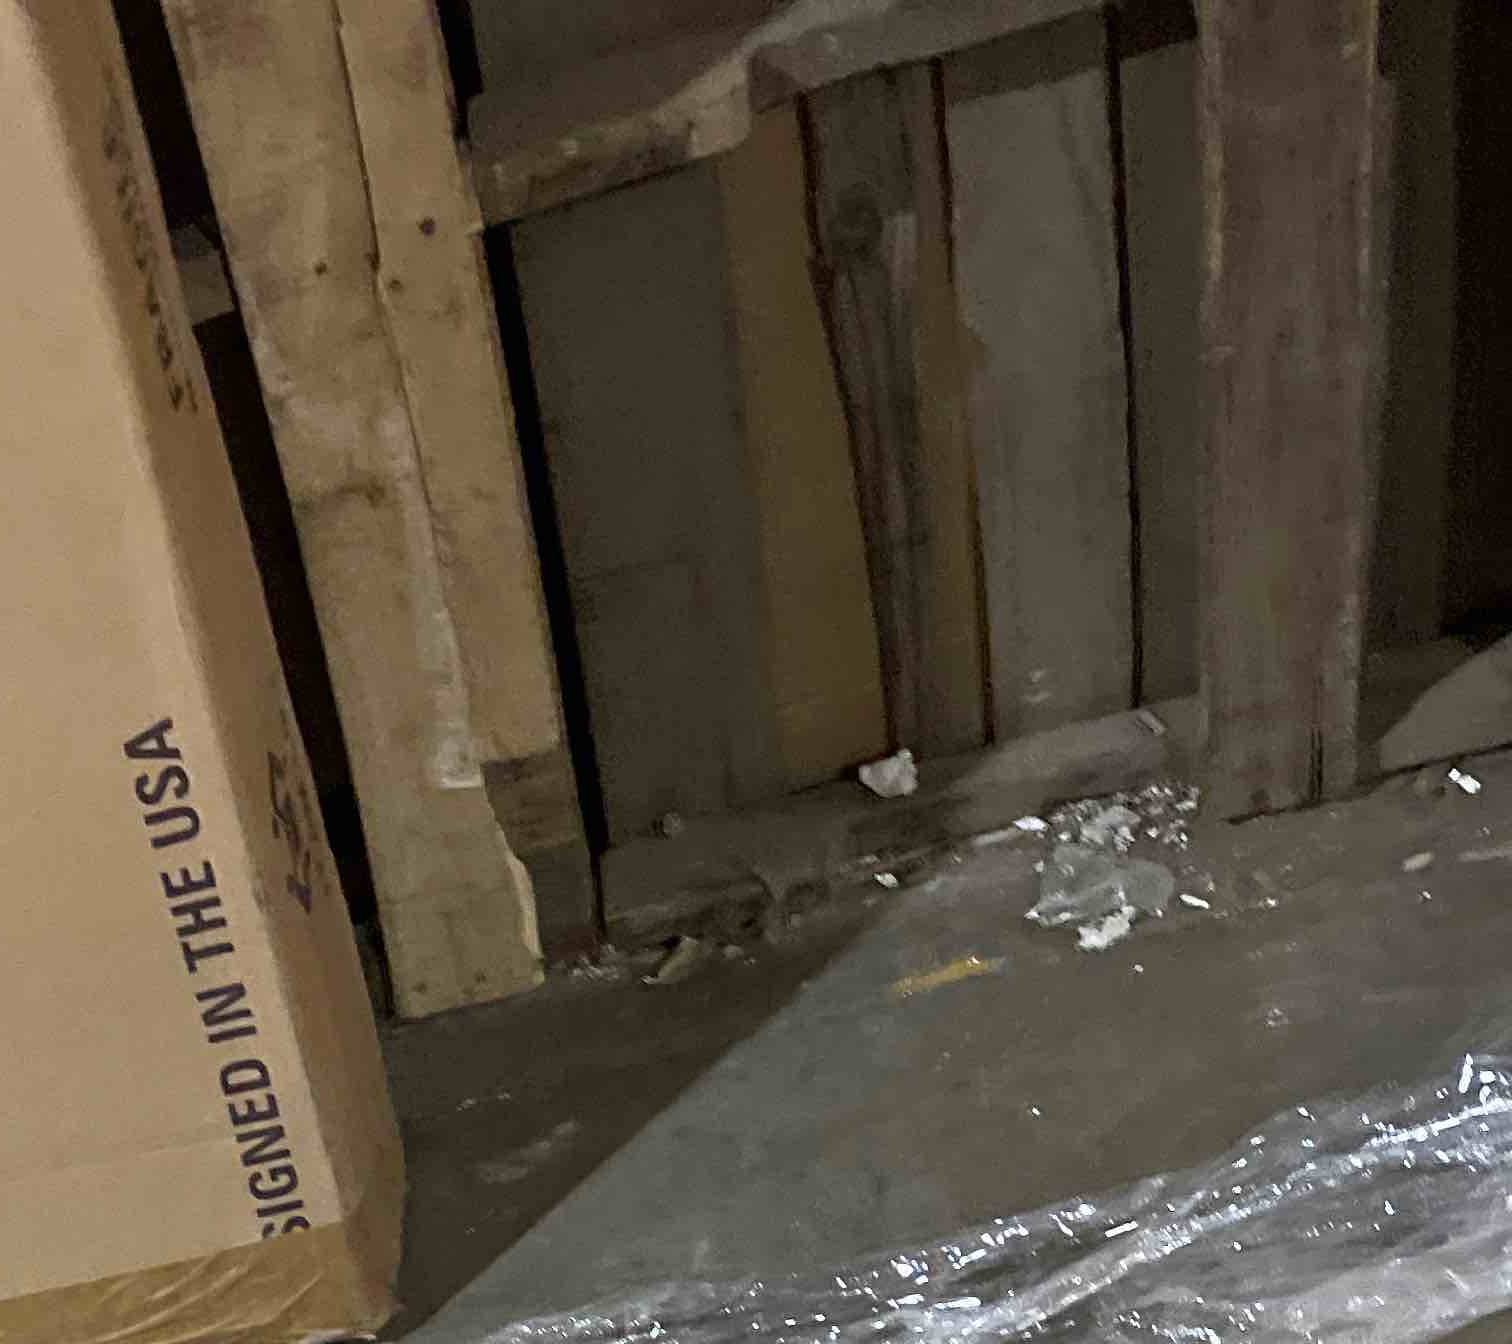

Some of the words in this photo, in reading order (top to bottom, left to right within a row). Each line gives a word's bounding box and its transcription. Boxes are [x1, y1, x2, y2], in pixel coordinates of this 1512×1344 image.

[122, 716, 201, 849] USA
[160, 859, 236, 975] THE
[194, 981, 259, 1043] IN
